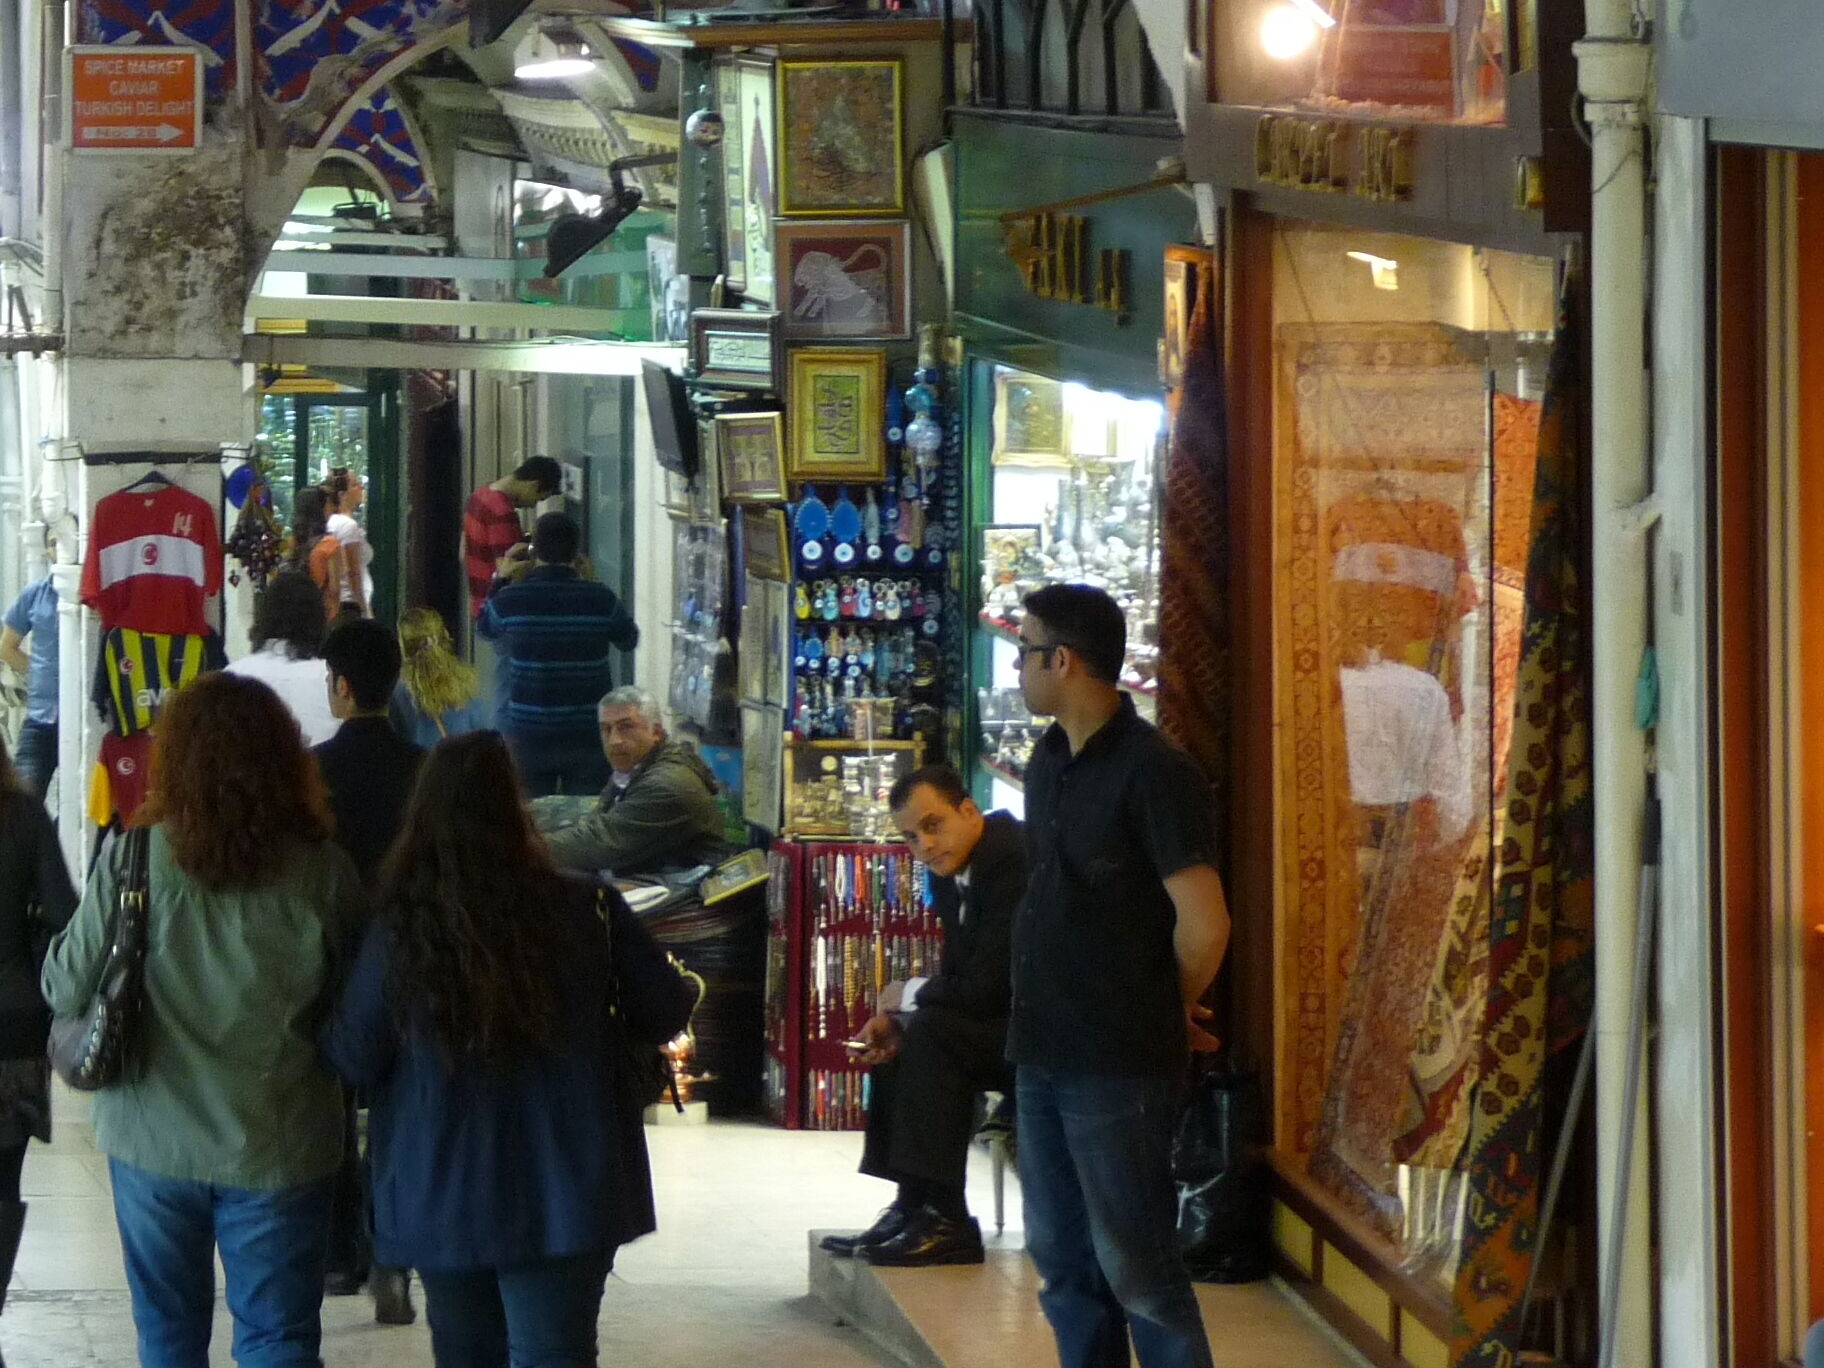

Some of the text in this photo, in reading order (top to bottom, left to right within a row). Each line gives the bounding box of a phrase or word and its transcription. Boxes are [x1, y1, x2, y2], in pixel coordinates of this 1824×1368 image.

[84, 59, 185, 75] SPICE MARKET
[109, 80, 161, 96] CAVIAR
[75, 100, 196, 117] TURKISH DELIGHT
